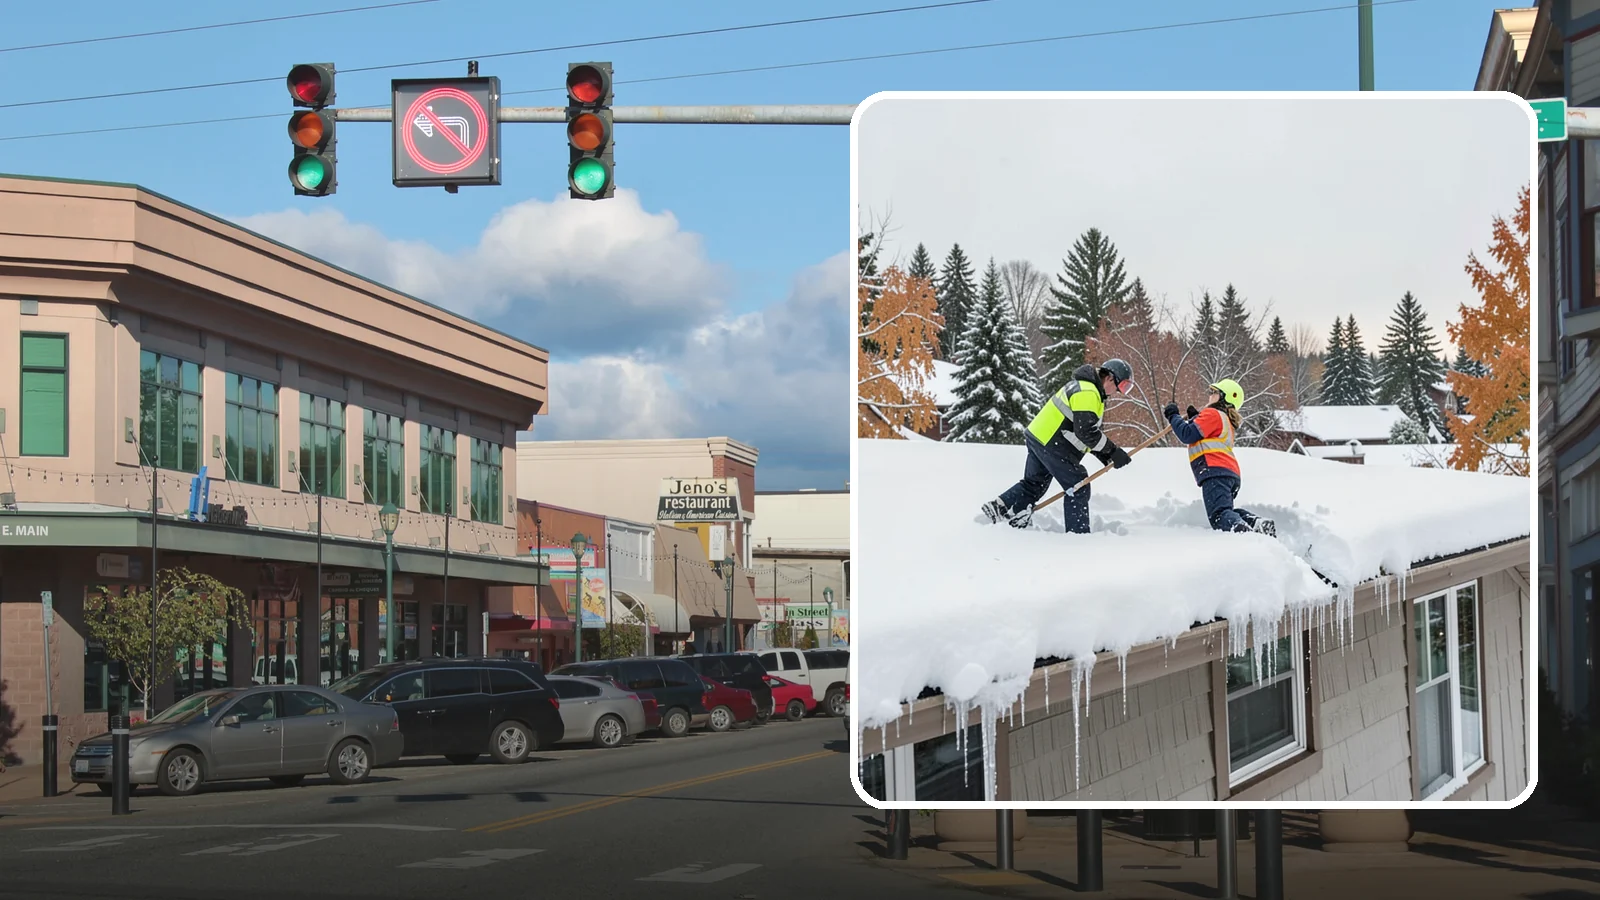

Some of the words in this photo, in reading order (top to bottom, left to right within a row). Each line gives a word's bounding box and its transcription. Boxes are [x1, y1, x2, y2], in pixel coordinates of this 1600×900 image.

[670, 480, 727, 494] Jeno's
[665, 497, 731, 509] restaurant
[686, 510, 714, 519] American
[715, 510, 737, 519] Cuisine
[2, 525, 13, 536] E.
[15, 525, 49, 536] MAIN
[797, 607, 828, 616] Street
